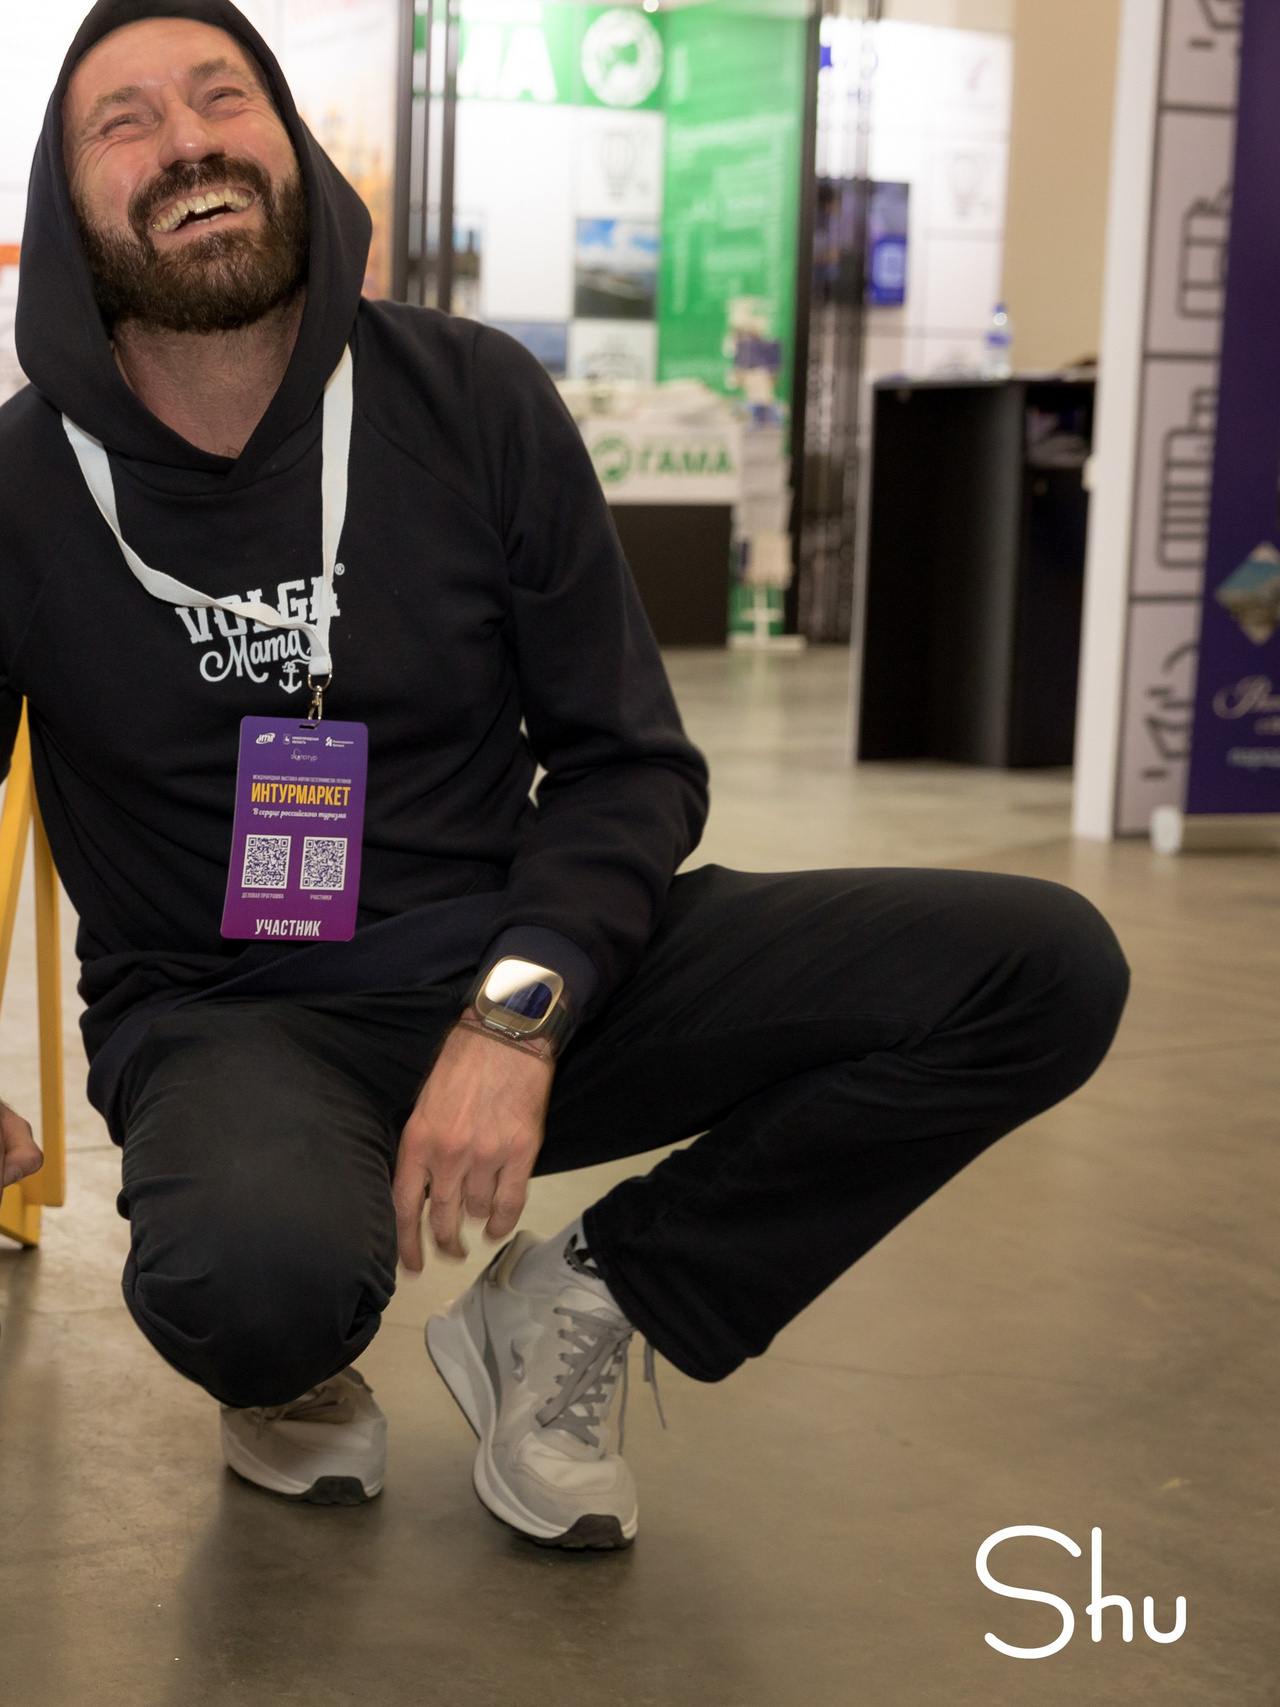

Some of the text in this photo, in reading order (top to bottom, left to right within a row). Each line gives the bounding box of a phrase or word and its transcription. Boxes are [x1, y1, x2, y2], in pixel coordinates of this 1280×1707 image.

[251, 782, 351, 806] ИНТУРМАРКЕТ
[252, 807, 347, 821] В сердце российского туризма
[254, 919, 322, 937] УЧАСТНИК
